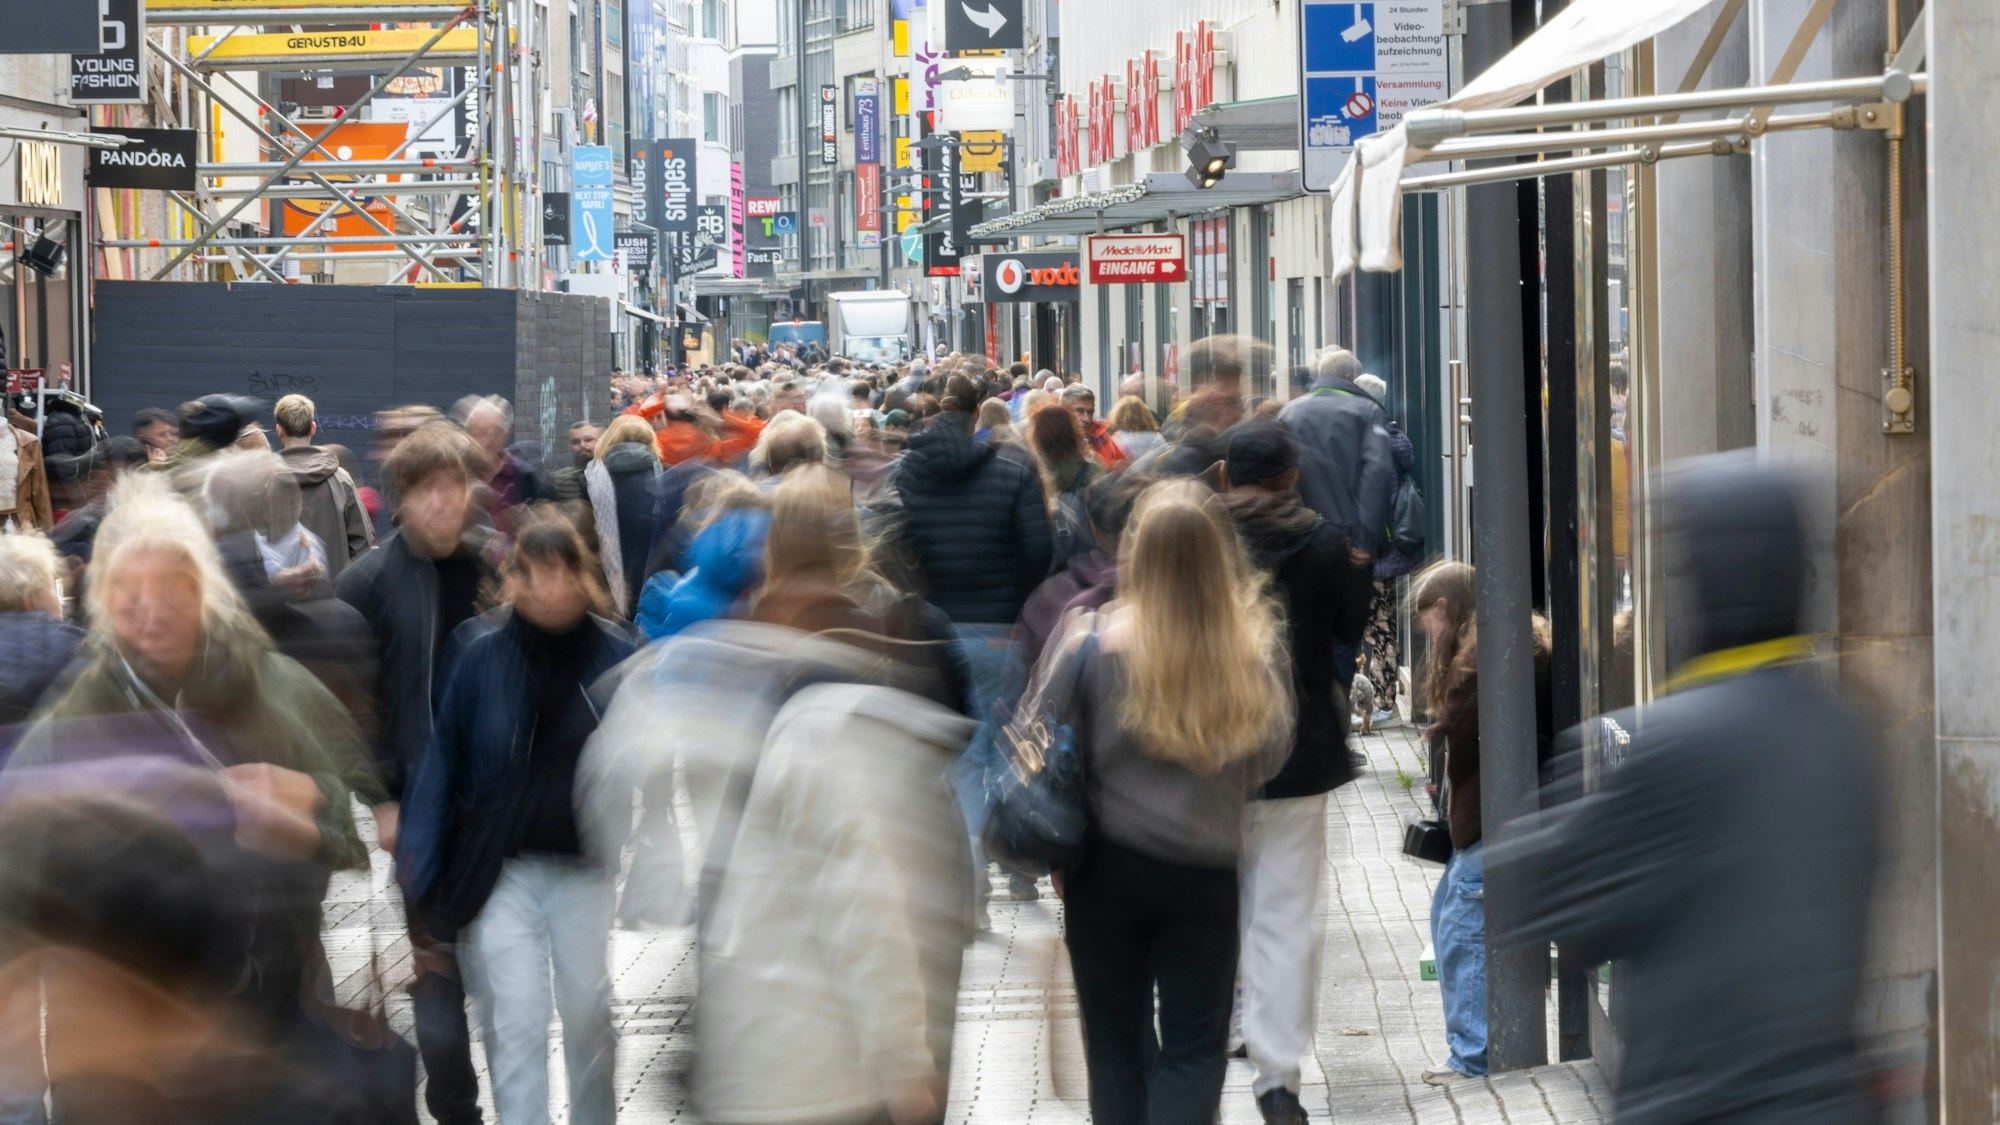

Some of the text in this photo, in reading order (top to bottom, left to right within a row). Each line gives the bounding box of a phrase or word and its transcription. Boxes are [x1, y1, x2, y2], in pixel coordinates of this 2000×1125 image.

[1393, 22, 1425, 31] Video-
[1376, 34, 1443, 44] beobachtung/
[1377, 46, 1443, 57] aufzeichnung
[75, 59, 134, 72] YOUNG
[72, 74, 140, 91] FASHION
[1376, 80, 1445, 90] Versammlung:
[858, 98, 873, 116] 73
[1380, 99, 1408, 107] Keine
[824, 142, 835, 162] FOOT
[663, 157, 691, 221] snipes
[618, 238, 648, 247] LUSH
[747, 252, 771, 263] Fast.
[1098, 261, 1156, 275] EINGANG
